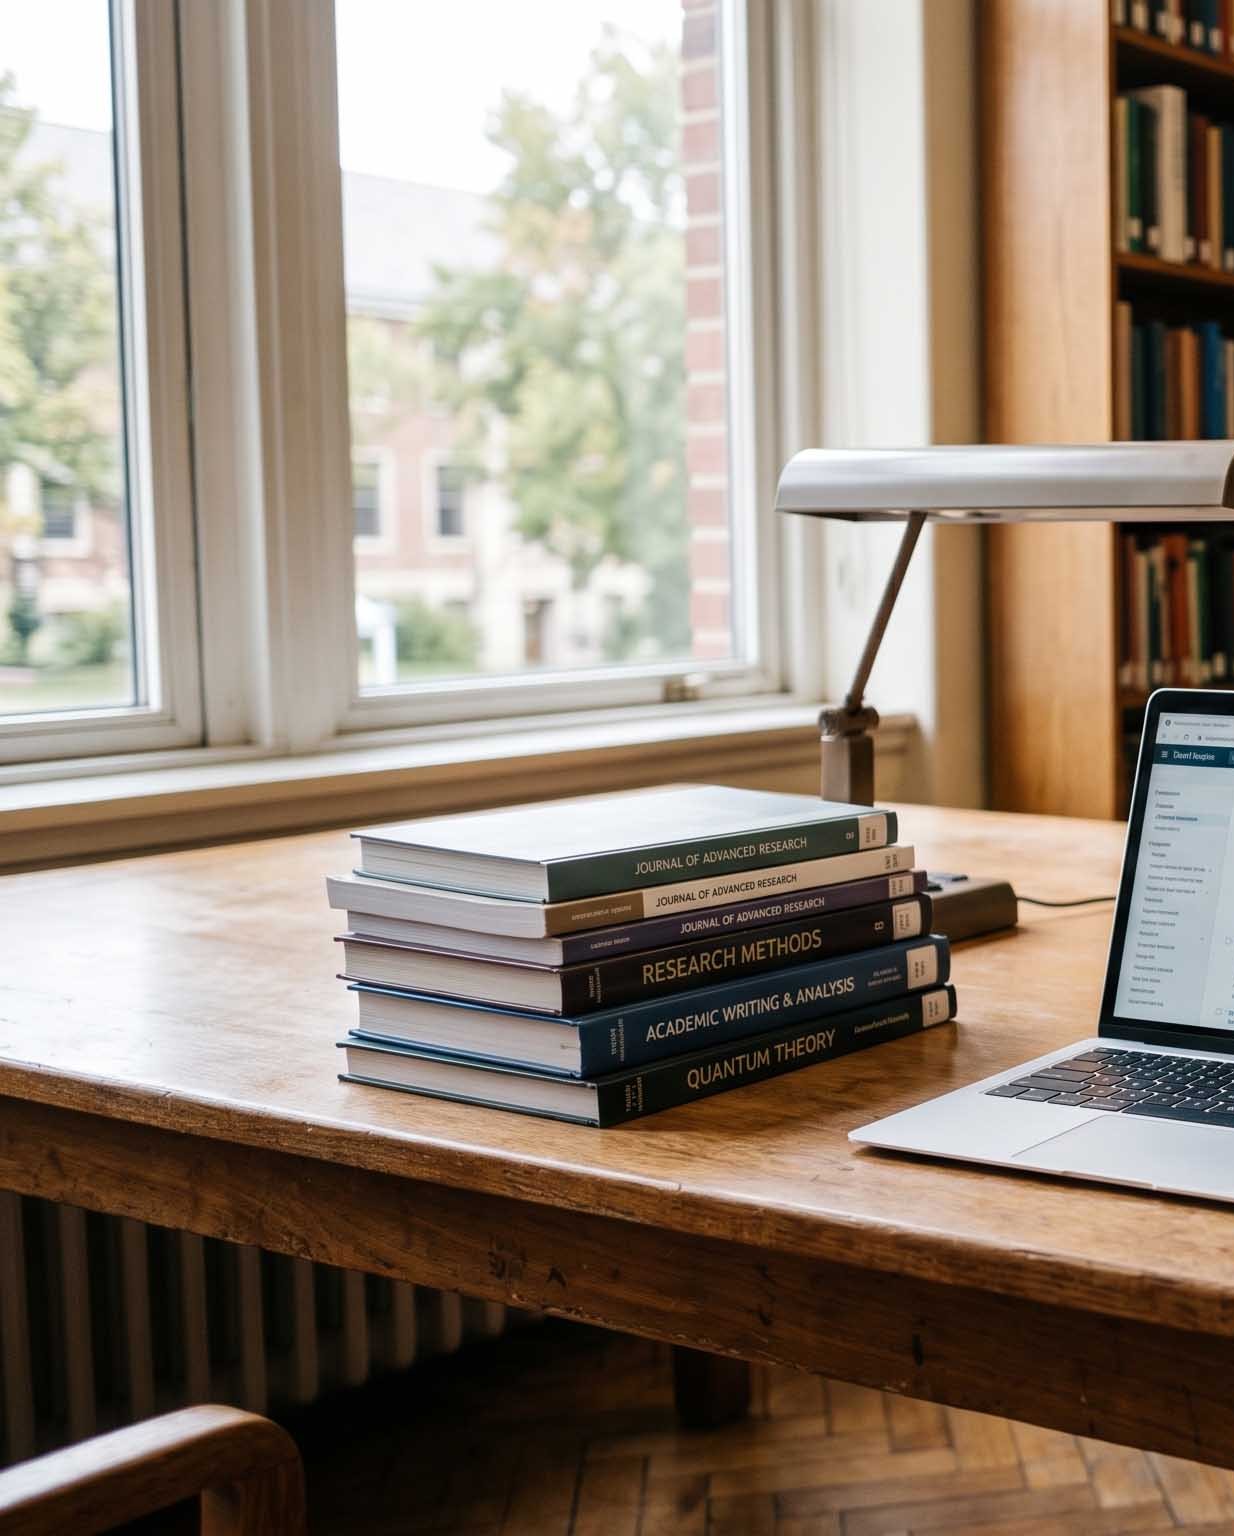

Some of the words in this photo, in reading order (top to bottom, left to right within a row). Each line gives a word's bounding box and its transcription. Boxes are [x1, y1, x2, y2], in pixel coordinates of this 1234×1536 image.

[635, 856, 684, 875] JOURNAL
[686, 854, 700, 867] OF
[703, 845, 756, 864] ADVANCED
[759, 836, 807, 855] RESEARCH
[656, 892, 696, 908] JOURNAL
[698, 889, 710, 900] OF
[712, 881, 756, 897] ADVANCED
[757, 873, 797, 889] RESEARCH
[680, 917, 721, 935] JOURNAL
[722, 913, 735, 926] OF
[736, 905, 783, 922] ADVANCED
[784, 897, 825, 913] RESEARCH
[642, 946, 737, 985] RESEARCH
[741, 929, 823, 965] METHODS
[646, 1009, 720, 1042] ACADEMIC
[722, 994, 780, 1023] WRITING
[783, 992, 793, 1007] &
[796, 976, 855, 1005] ANALYSIS
[687, 1053, 771, 1089] QUANTUM
[774, 1028, 837, 1062] THEORY
